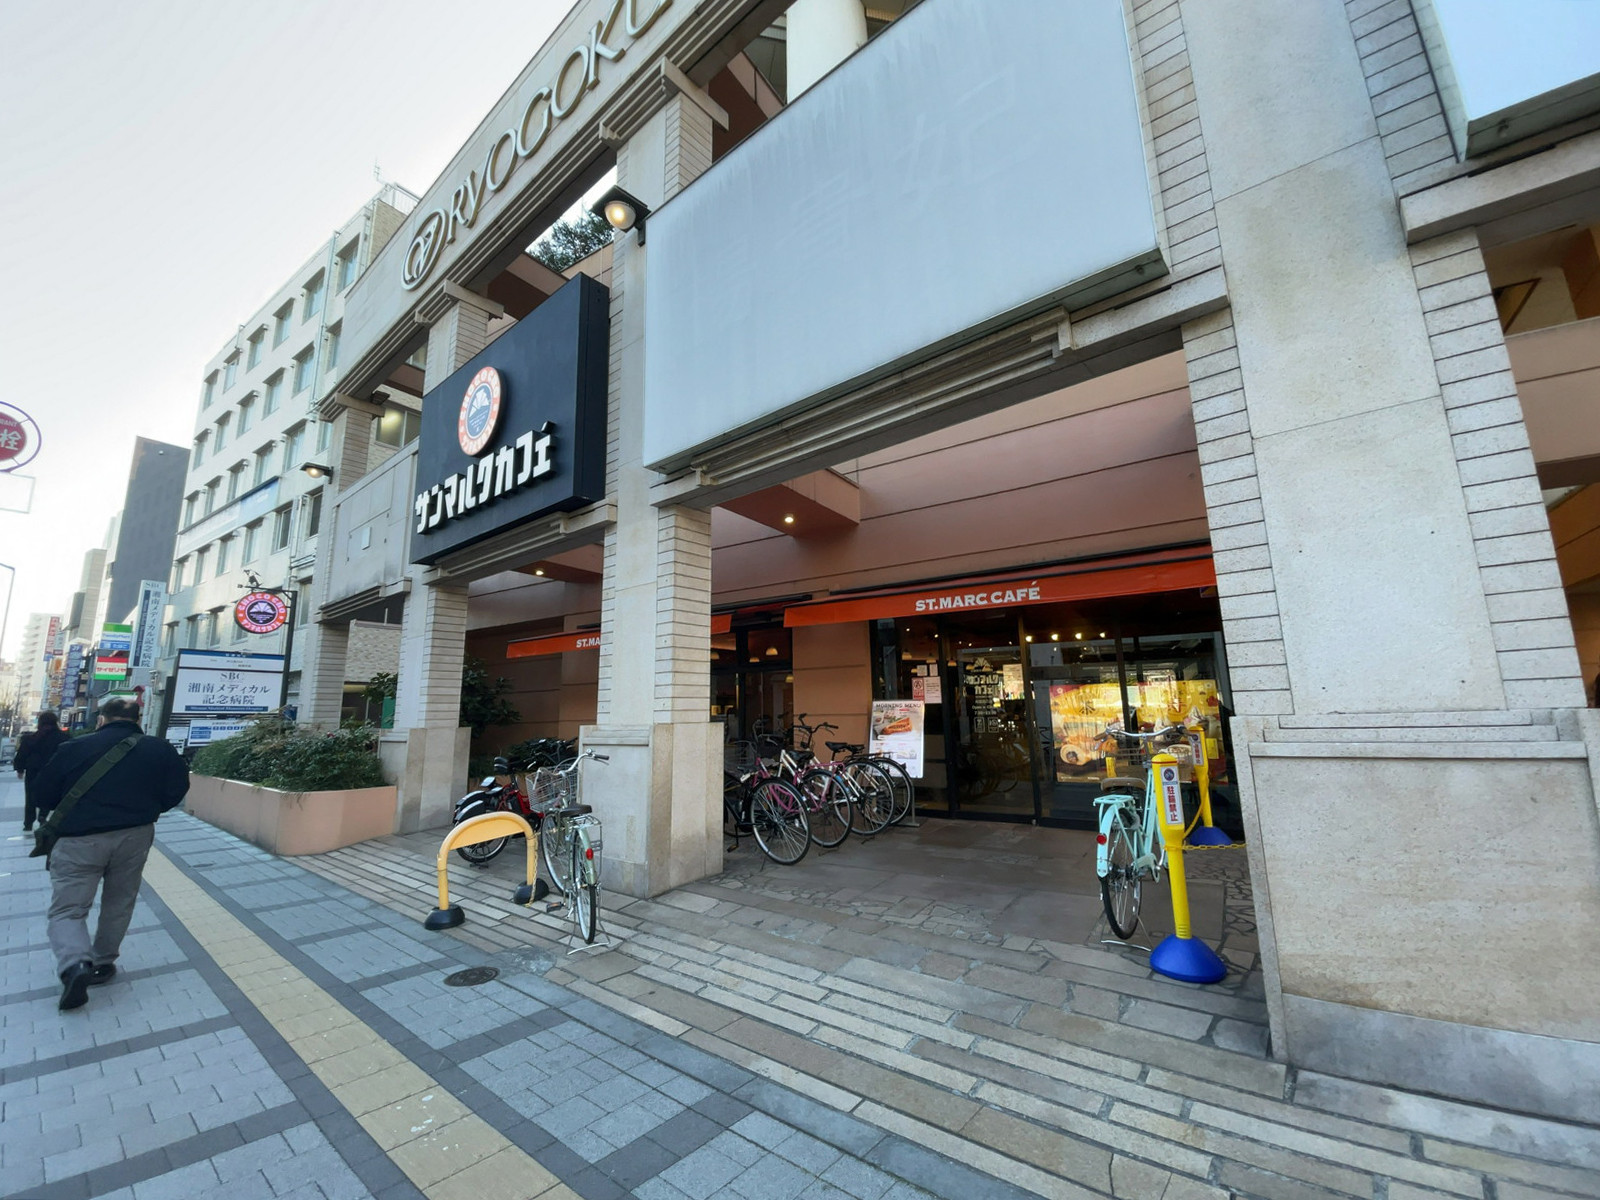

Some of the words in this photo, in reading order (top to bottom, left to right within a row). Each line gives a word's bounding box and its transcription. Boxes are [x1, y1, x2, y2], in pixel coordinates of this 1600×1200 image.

[414, 421, 552, 534] サンマルクカフェ
[915, 593, 988, 612] ST.MARC
[990, 581, 1041, 604] CAFÉ
[188, 682, 271, 694] 湘南メディカル
[202, 694, 255, 705] 記念病院
